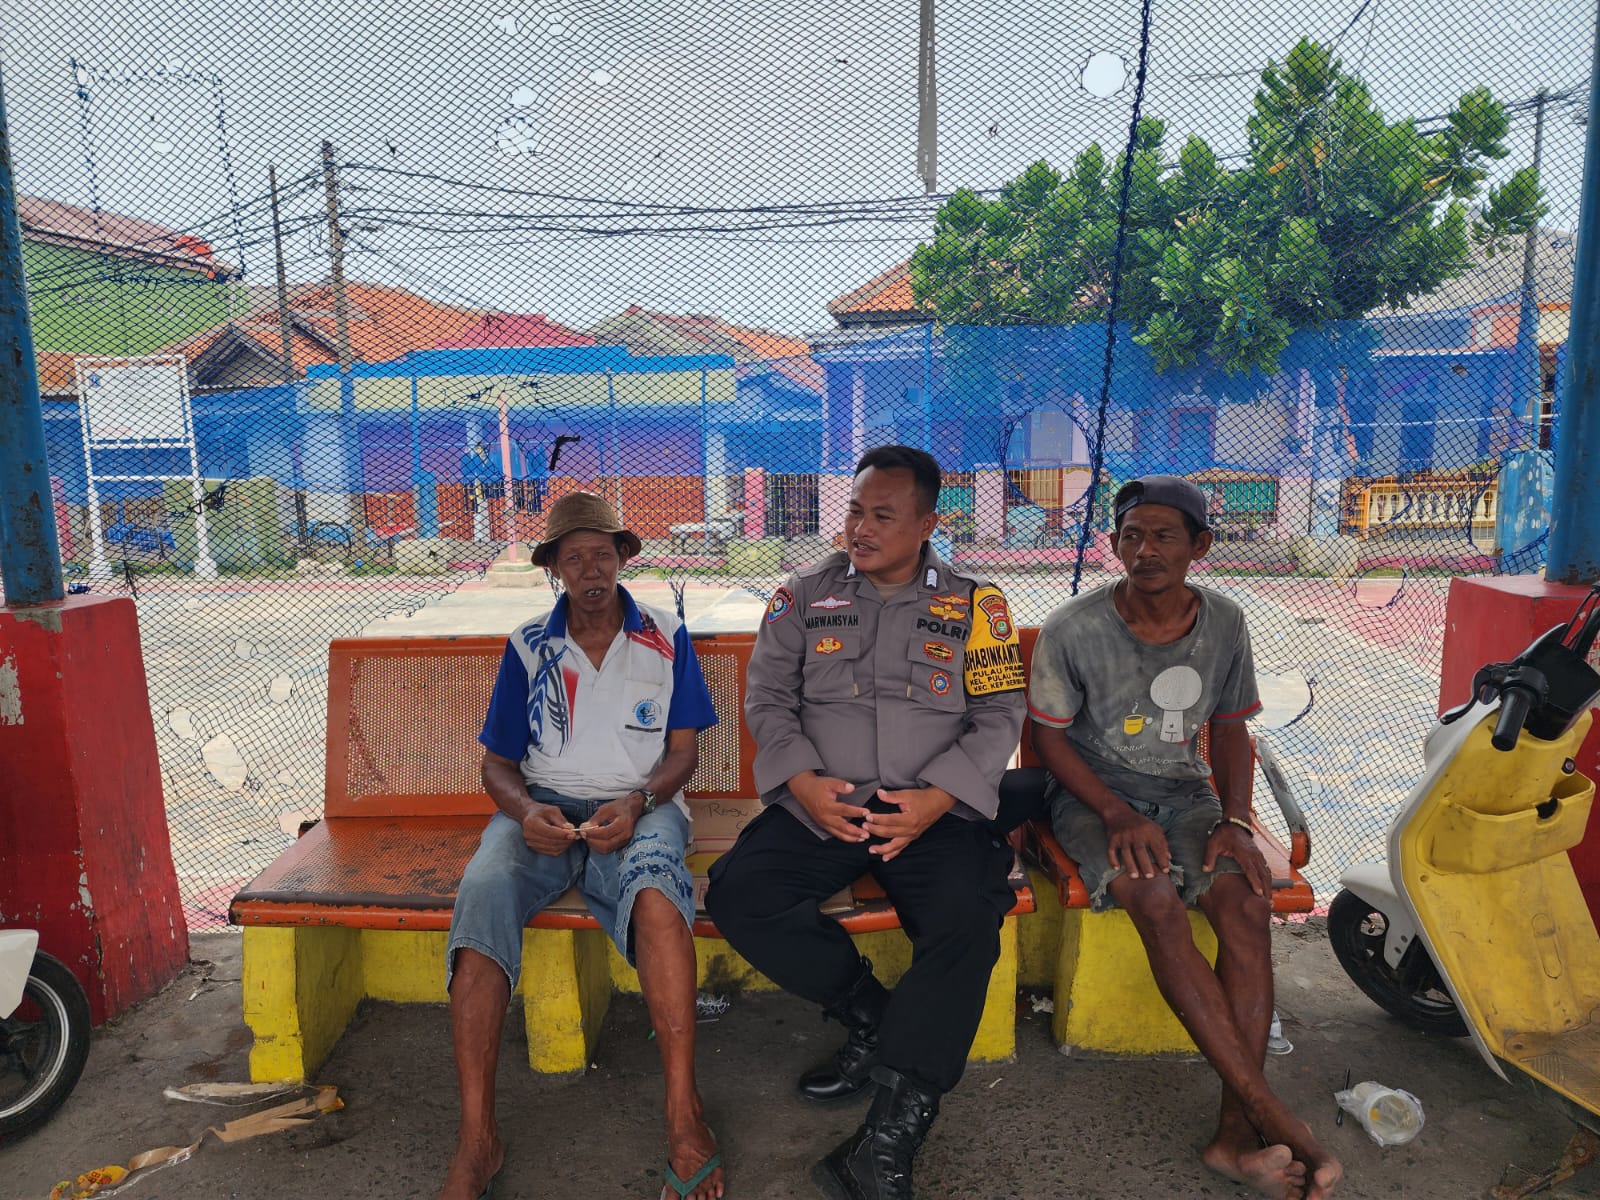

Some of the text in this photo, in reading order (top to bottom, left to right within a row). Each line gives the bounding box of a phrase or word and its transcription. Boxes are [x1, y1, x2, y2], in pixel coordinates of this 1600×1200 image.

[804, 614, 859, 630] MARWANSYAH
[916, 618, 968, 641] POLRI
[973, 667, 1002, 678] PULAU
[988, 673, 1011, 682] PULAU
